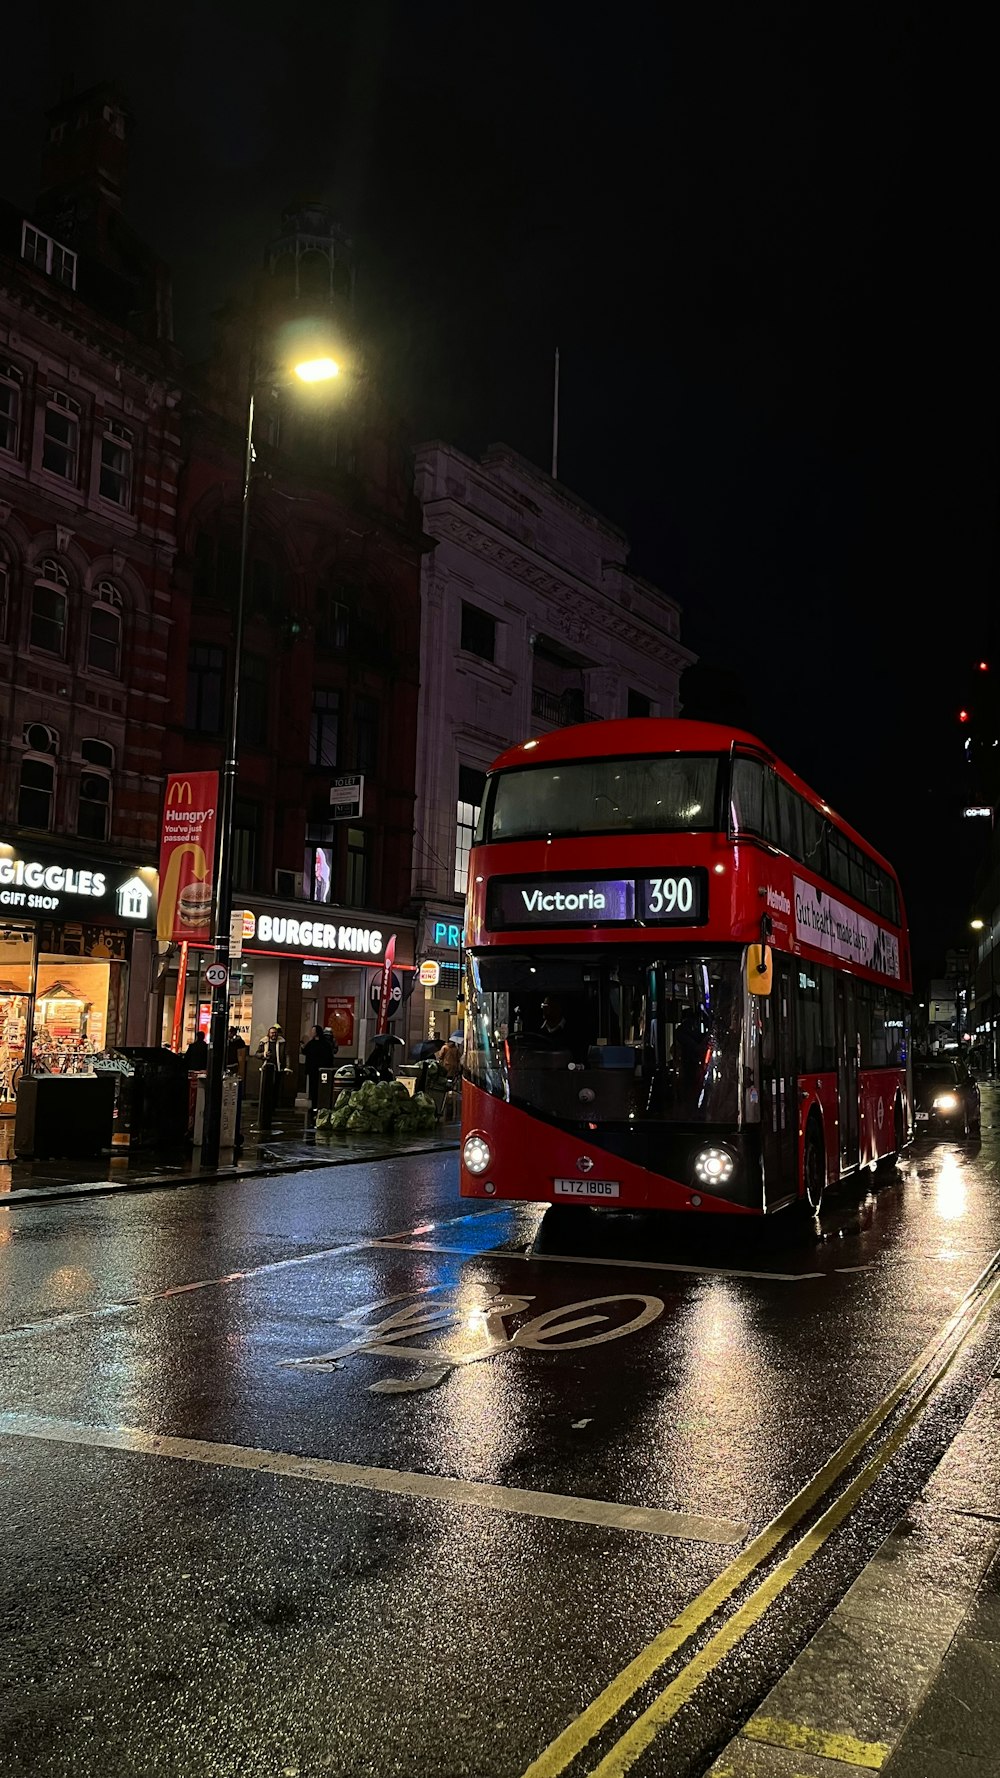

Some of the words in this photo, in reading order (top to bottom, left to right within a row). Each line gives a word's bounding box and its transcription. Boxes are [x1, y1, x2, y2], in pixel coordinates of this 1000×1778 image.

[335, 779, 344, 787] TO
[344, 777, 356, 786] LET
[166, 808, 214, 824] Hungry?
[164, 825, 187, 834] You've
[187, 824, 203, 834] just
[163, 834, 190, 843] passed
[190, 834, 200, 842] us
[0, 858, 107, 898] GIGGLES
[0, 890, 27, 907] GIFT
[27, 893, 60, 910] SHOP
[521, 889, 605, 912] Victoria
[648, 877, 693, 913] 390
[796, 893, 811, 928] Gut
[836, 919, 852, 946] made
[257, 914, 336, 950] BURGER
[338, 926, 383, 954] KING
[208, 968, 226, 982] 20
[561, 1180, 584, 1193] LTZ
[586, 1182, 612, 1194] 1806
